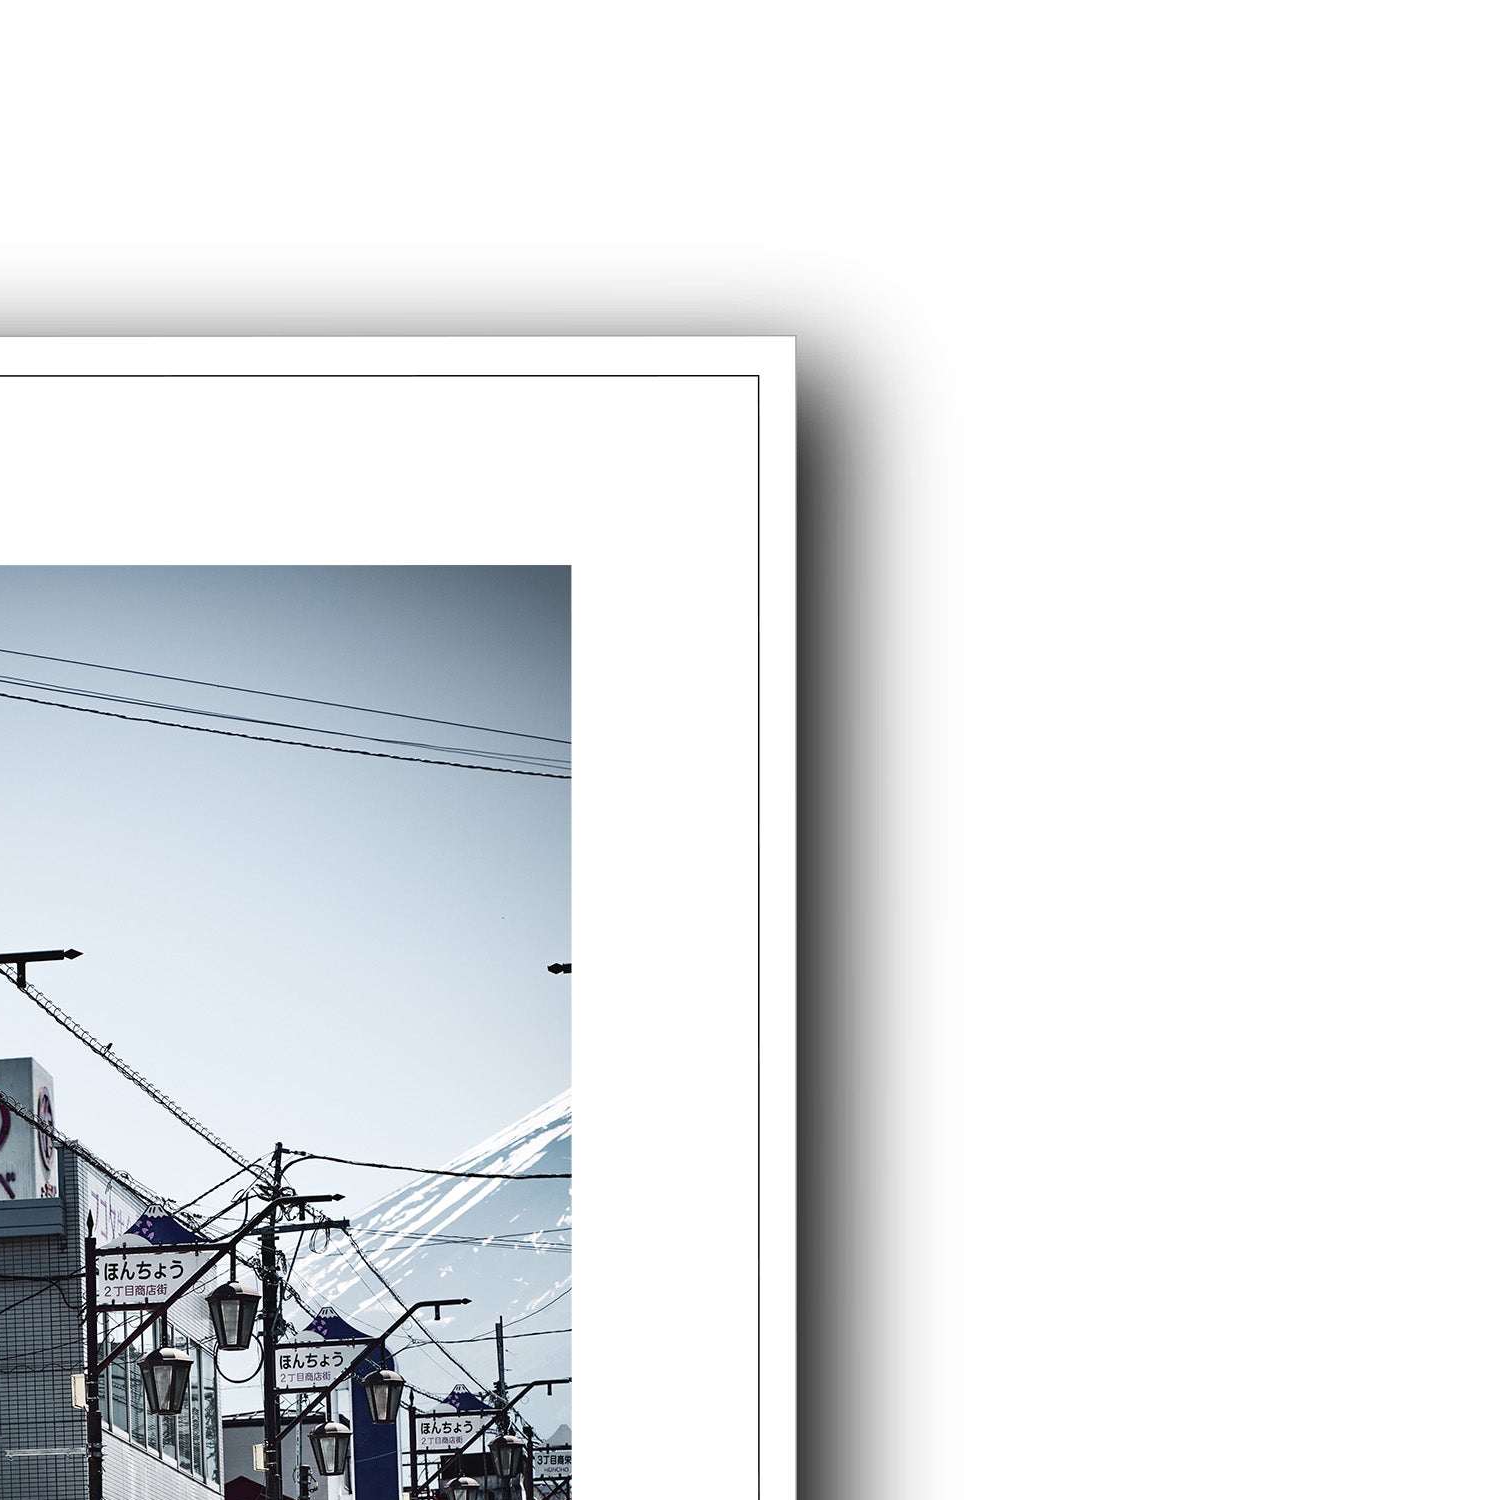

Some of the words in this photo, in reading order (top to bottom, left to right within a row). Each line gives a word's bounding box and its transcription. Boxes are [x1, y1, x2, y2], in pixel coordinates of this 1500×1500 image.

[104, 1260, 184, 1281] ほんちょう
[104, 1284, 167, 1297] 2丁目商店街
[279, 1351, 344, 1369] ほんちょう
[280, 1371, 331, 1382] 2丁目商店街
[420, 1420, 473, 1434] ほんちょう
